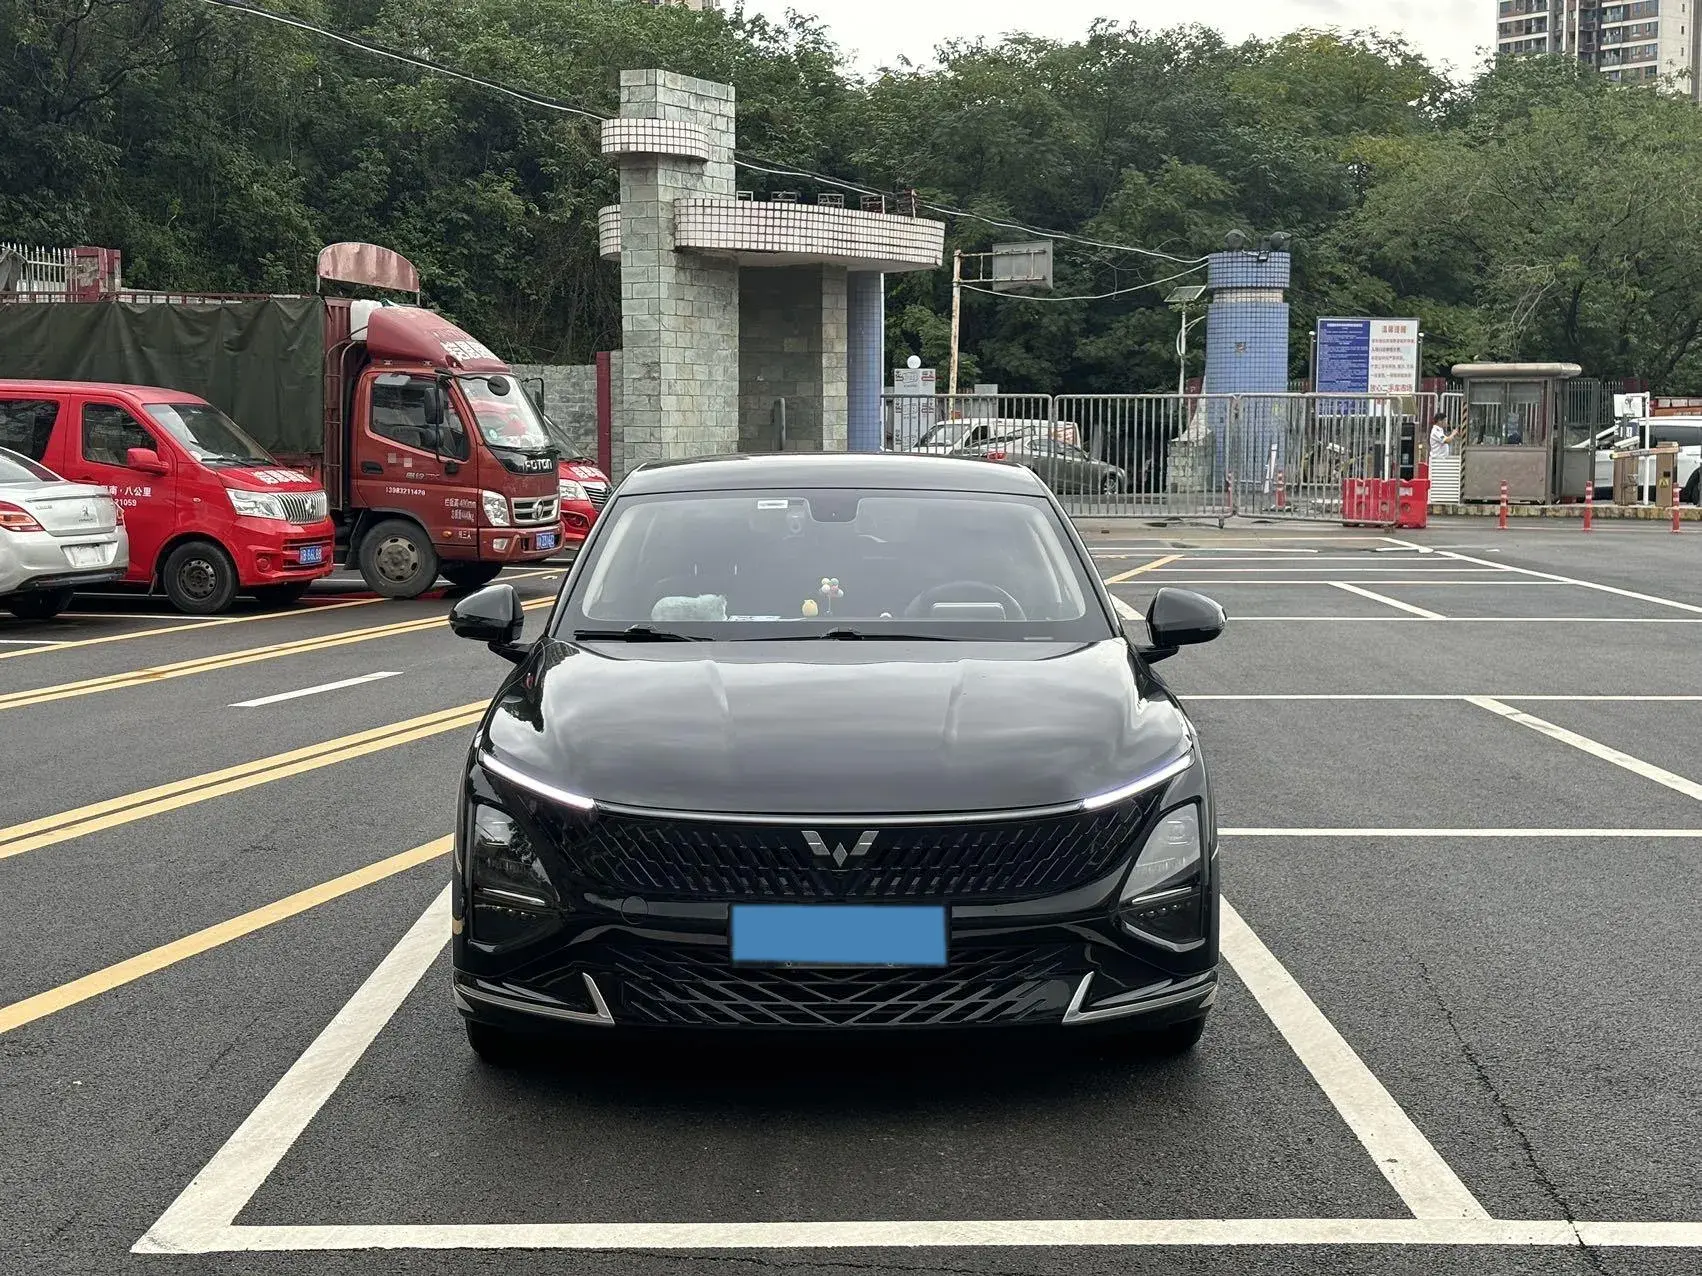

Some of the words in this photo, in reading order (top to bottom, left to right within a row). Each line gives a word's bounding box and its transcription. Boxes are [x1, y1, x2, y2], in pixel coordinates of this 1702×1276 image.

[524, 459, 553, 470] FOTON
[101, 485, 152, 497] 南·八公里
